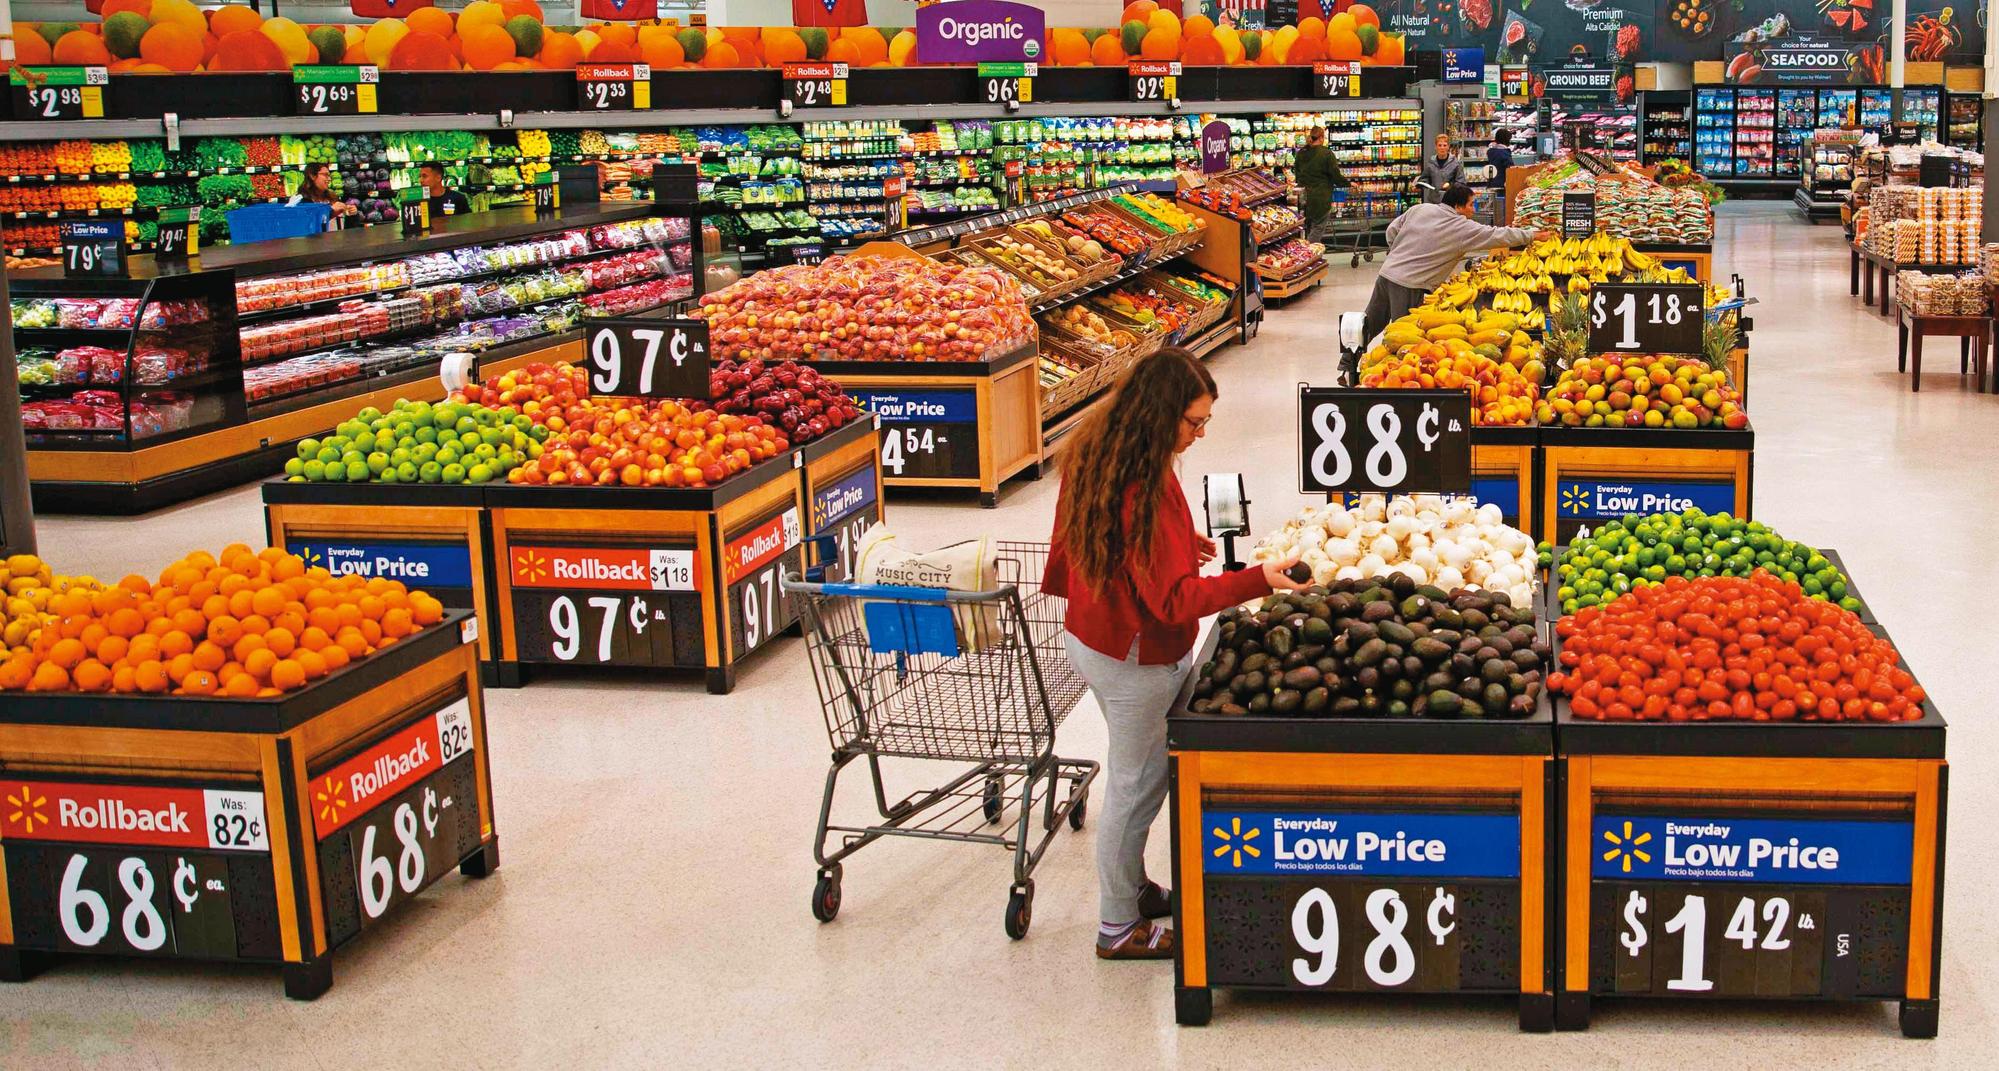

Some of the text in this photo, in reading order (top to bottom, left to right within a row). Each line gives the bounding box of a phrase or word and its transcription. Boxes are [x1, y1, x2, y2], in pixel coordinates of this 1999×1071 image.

[1390, 14, 1430, 26] All Natural
[1583, 7, 1623, 20] Premium
[939, 17, 1024, 46] Organic
[1599, 22, 1621, 31] Calidad
[1771, 54, 1839, 66] SEAFOOD
[593, 69, 630, 77] Rollback
[797, 67, 831, 75] Rollback
[1446, 70, 1460, 79] Low
[1460, 70, 1477, 79] Price
[1550, 75, 1610, 85] GROUND BEEF
[586, 82, 626, 108] $233
[796, 80, 832, 105] $248
[1323, 75, 1349, 96] $267
[29, 88, 81, 117] $298
[301, 85, 348, 113] $269
[1207, 136, 1227, 159] Organic
[73, 225, 109, 234] Low Price
[1566, 219, 1592, 227] FRESH
[66, 244, 103, 271] 79¢
[1591, 291, 1682, 349] $118
[592, 328, 688, 395] 97¢
[871, 395, 899, 403] Everyday
[906, 401, 946, 416] Price
[1447, 419, 1463, 433] lb.
[1310, 402, 1440, 488] 88¢
[1596, 485, 1633, 495] Everyday
[827, 496, 844, 518] Low
[844, 486, 863, 508] Price
[1596, 493, 1694, 512] Low Price
[327, 547, 365, 558] Everyday
[741, 527, 782, 566] Rollback
[328, 556, 429, 577] Low Price
[552, 558, 647, 581] Rollback
[659, 555, 679, 565] Was:
[650, 566, 689, 588] $118
[875, 567, 953, 584] MUSIC CITY
[654, 609, 666, 620] lb.
[550, 595, 649, 662] 97¢
[443, 711, 458, 724] Was:
[441, 722, 468, 760] 82¢
[350, 737, 430, 803] Rollback
[220, 797, 247, 811] Was:
[58, 798, 191, 834] Rollback
[1273, 818, 1337, 831] Everyday
[213, 814, 261, 847] 82¢
[1665, 822, 1731, 839] Everyday
[361, 787, 439, 918] 68¢
[1273, 831, 1447, 862] Low Price
[1665, 836, 1840, 869] Low Price
[1274, 861, 1364, 871] Precio bajo todos los días
[1664, 867, 1754, 877] Precio bajo todos los días
[206, 879, 225, 892] ea.
[59, 853, 199, 951] 68¢
[1797, 913, 1816, 930] lb.
[1291, 886, 1456, 987] 98¢
[1620, 890, 1791, 991] $142
[1837, 933, 1850, 957] USA
